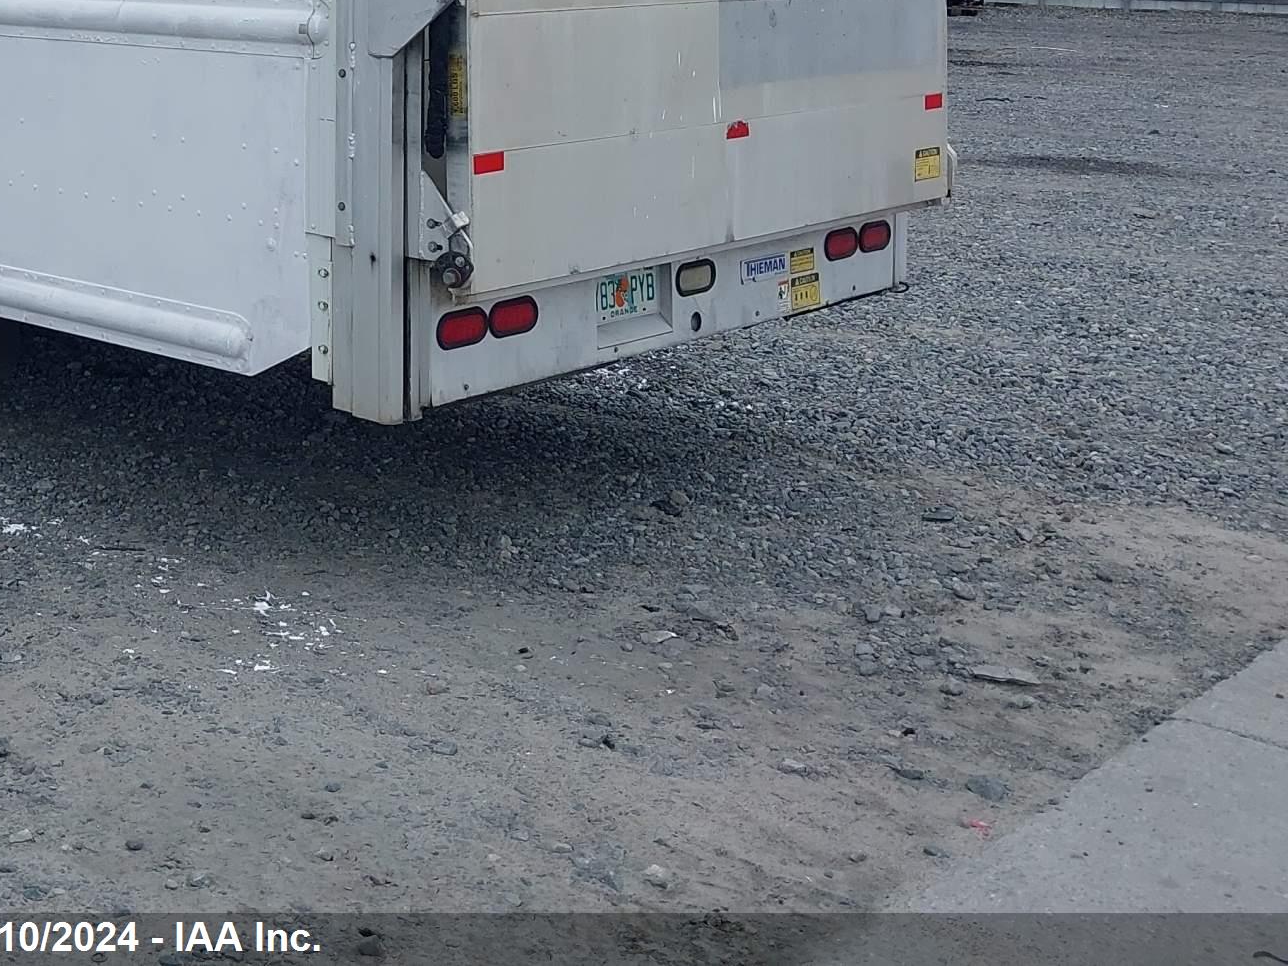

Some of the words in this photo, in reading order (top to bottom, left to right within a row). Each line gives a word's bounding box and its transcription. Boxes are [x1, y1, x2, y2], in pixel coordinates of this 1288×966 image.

[744, 254, 786, 277] THIEMAN
[630, 272, 655, 304] PYB
[610, 305, 638, 318] ORANGE
